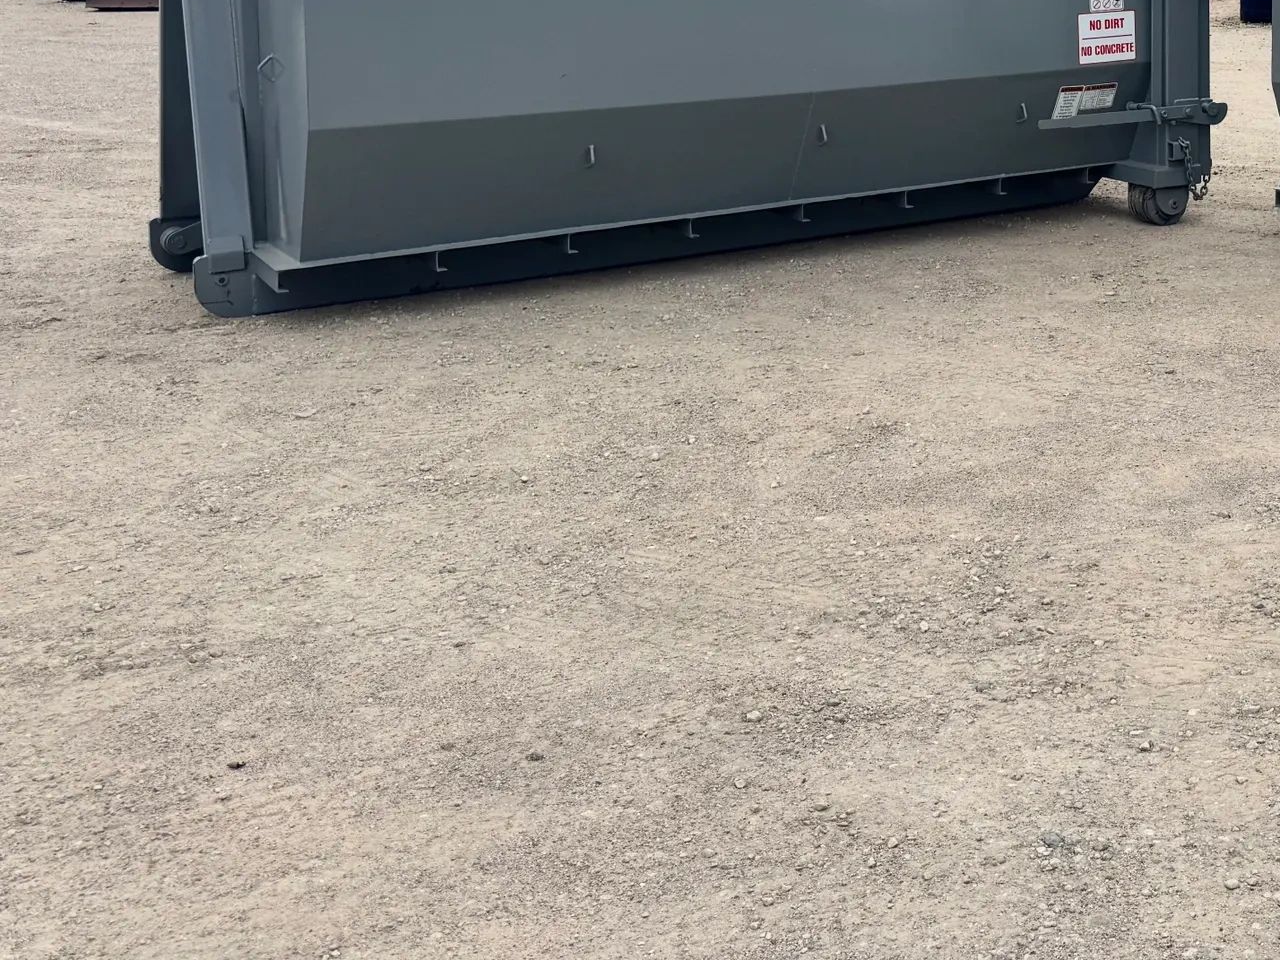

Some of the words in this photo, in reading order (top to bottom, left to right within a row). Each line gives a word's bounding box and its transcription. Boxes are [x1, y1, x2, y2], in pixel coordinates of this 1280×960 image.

[1089, 20, 1102, 31] NO
[1104, 18, 1125, 29] DIRT
[1081, 46, 1093, 57] NO
[1095, 42, 1135, 56] CONCRETE
